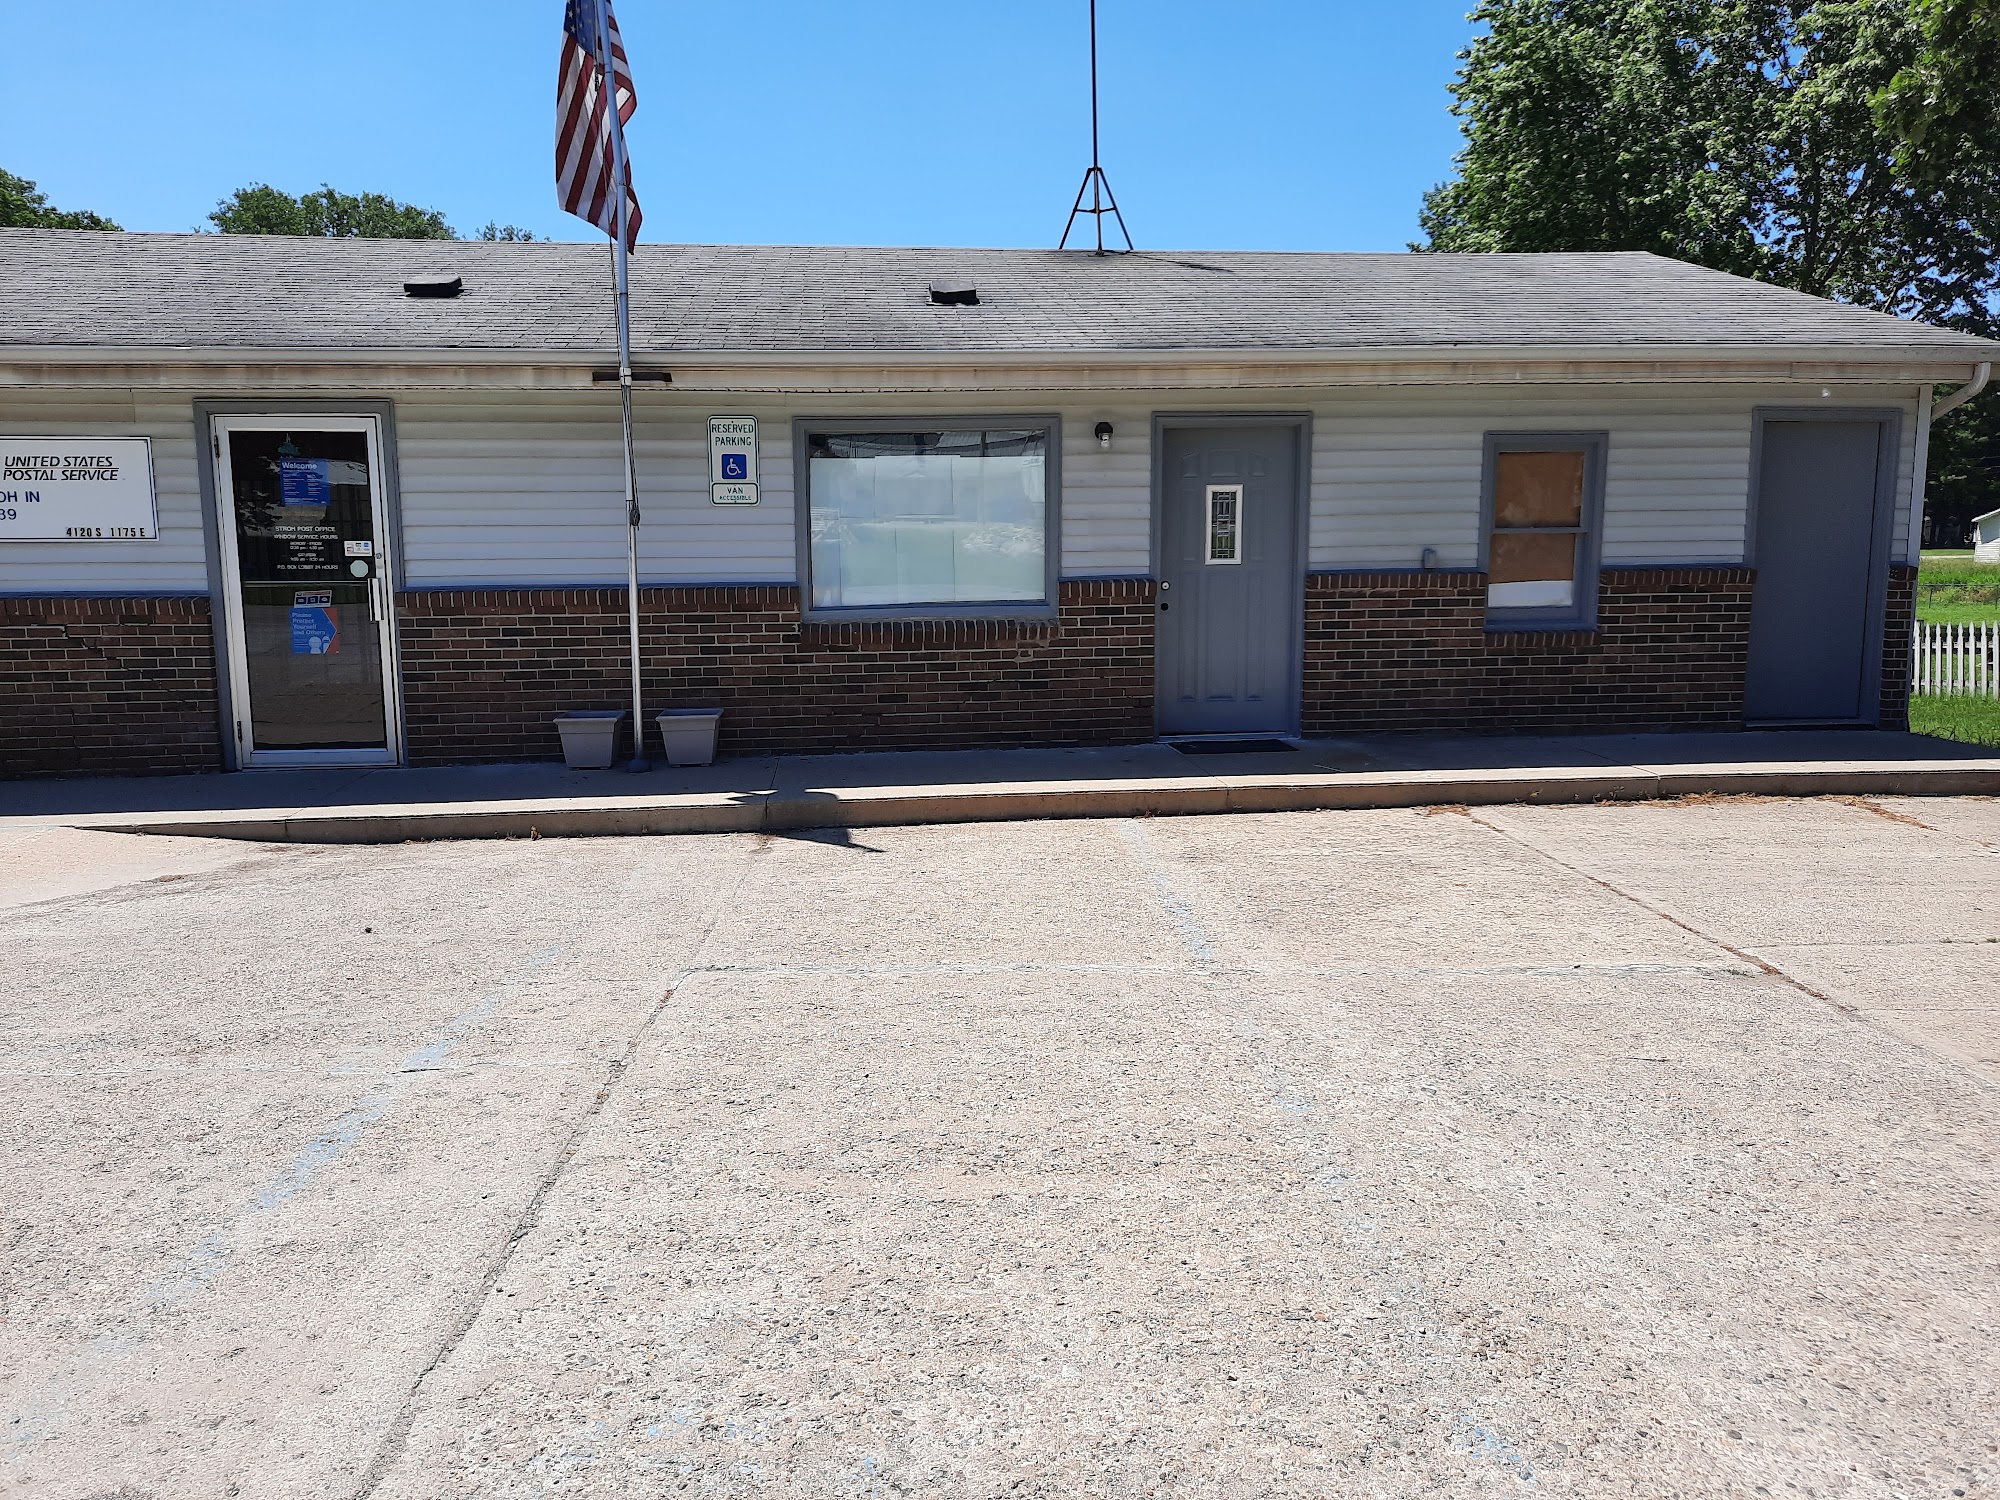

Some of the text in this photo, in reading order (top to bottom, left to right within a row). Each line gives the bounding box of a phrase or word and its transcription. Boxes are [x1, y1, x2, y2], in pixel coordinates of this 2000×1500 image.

[711, 424, 754, 434] RESERVED
[715, 436, 752, 446] PARKING
[5, 456, 113, 467] UNITED STATES
[3, 470, 119, 480] POSTAL SERVICE
[25, 491, 40, 502] IN
[66, 528, 146, 537] 4120 S 1175 E
